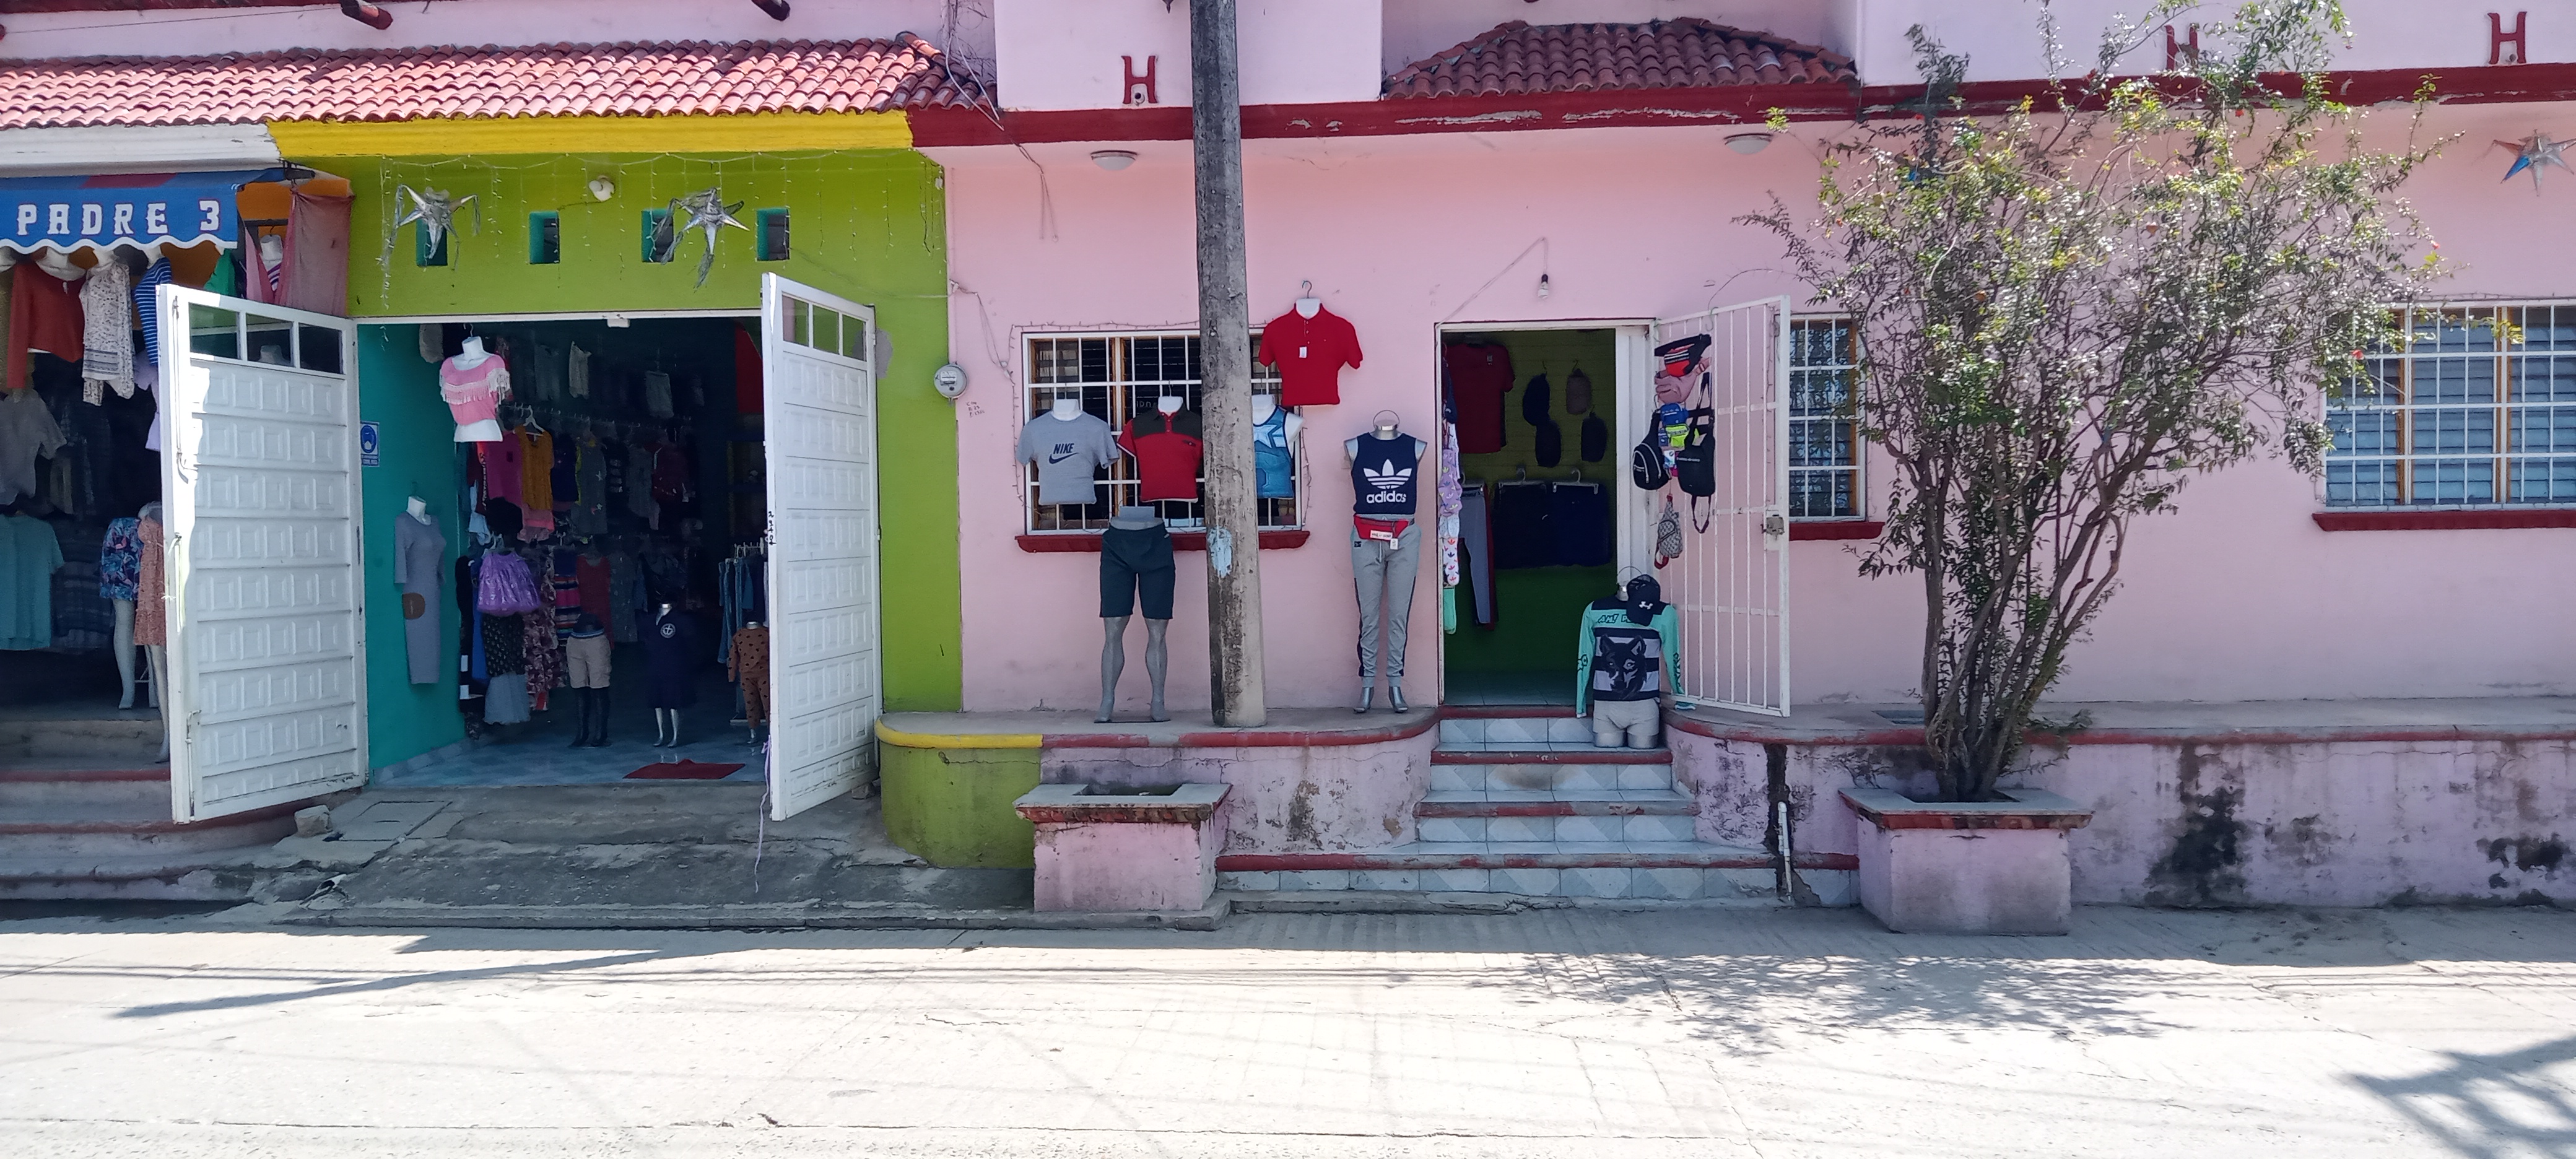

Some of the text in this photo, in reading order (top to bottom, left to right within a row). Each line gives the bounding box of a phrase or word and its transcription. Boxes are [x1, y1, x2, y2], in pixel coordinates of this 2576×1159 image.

[2487, 11, 2527, 64] H
[1121, 55, 1158, 105] H
[17, 200, 220, 235] PADRE 3
[1053, 443, 1074, 454] NIKE
[1366, 490, 1406, 503] adidas
